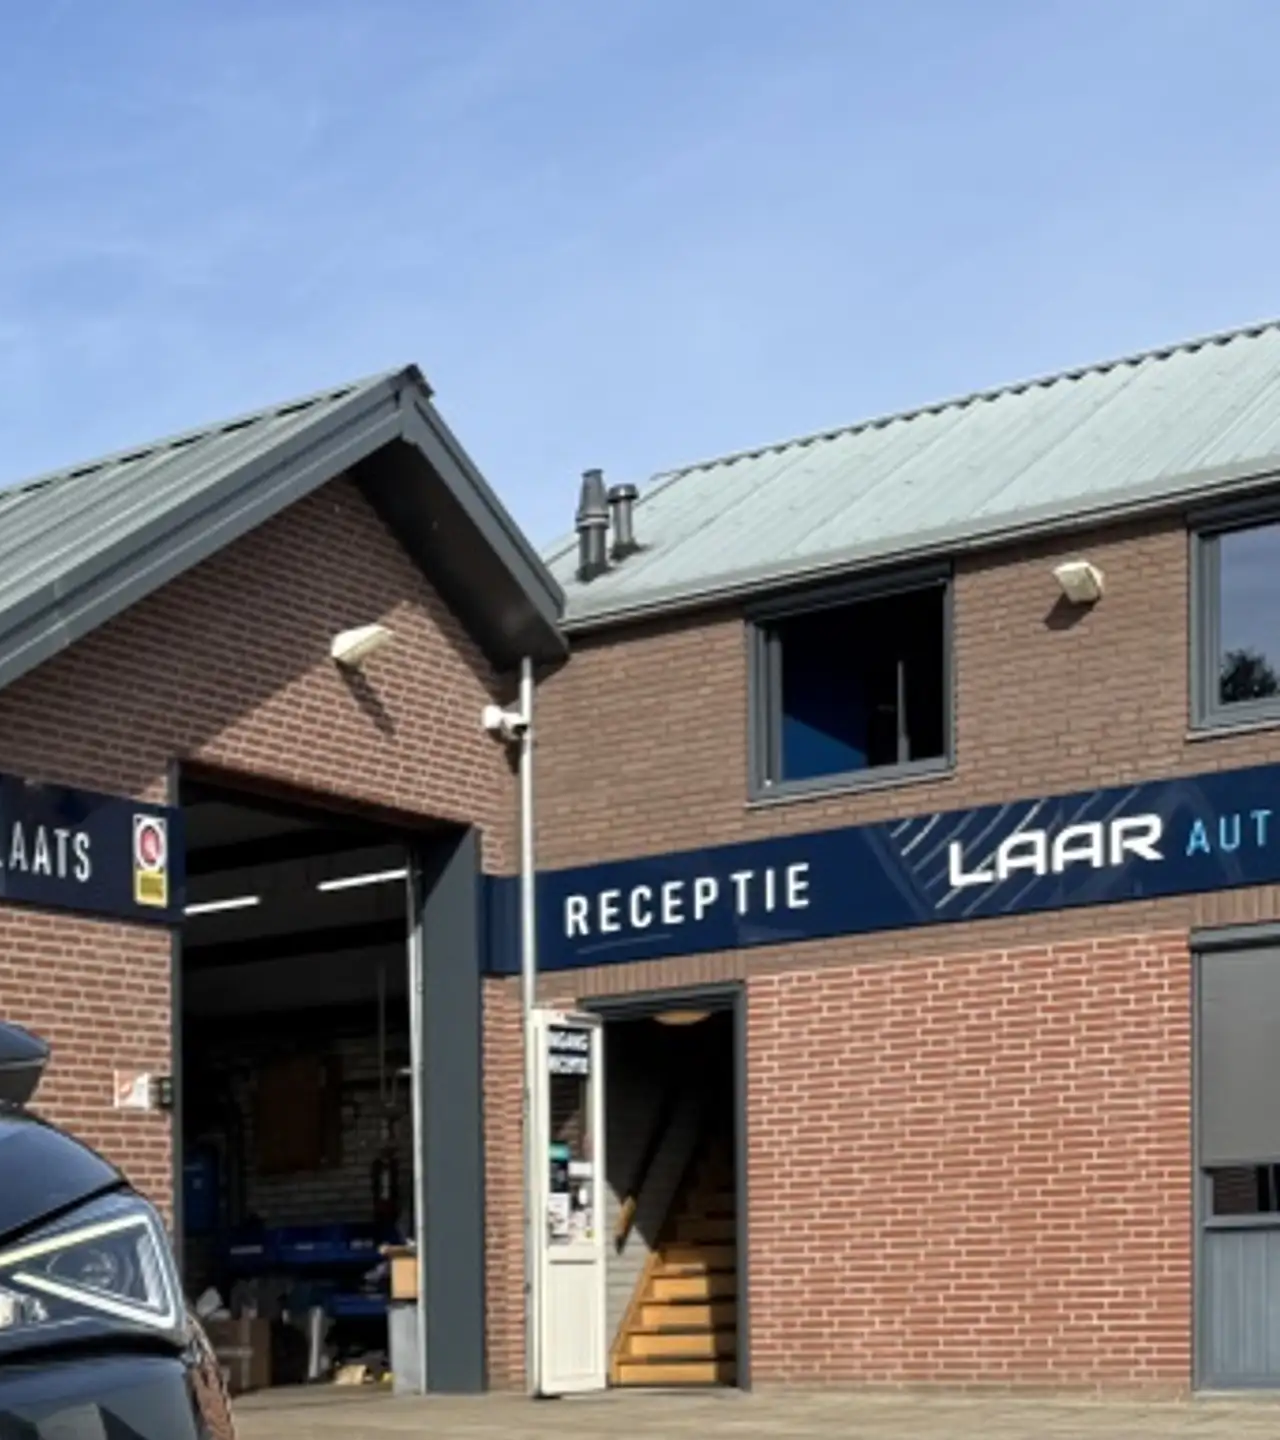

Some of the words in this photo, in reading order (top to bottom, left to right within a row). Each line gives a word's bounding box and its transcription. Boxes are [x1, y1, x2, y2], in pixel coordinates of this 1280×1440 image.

[948, 813, 1164, 888] LAAR
[1184, 809, 1273, 857] AUT
[564, 862, 810, 938] RECEPTIE
